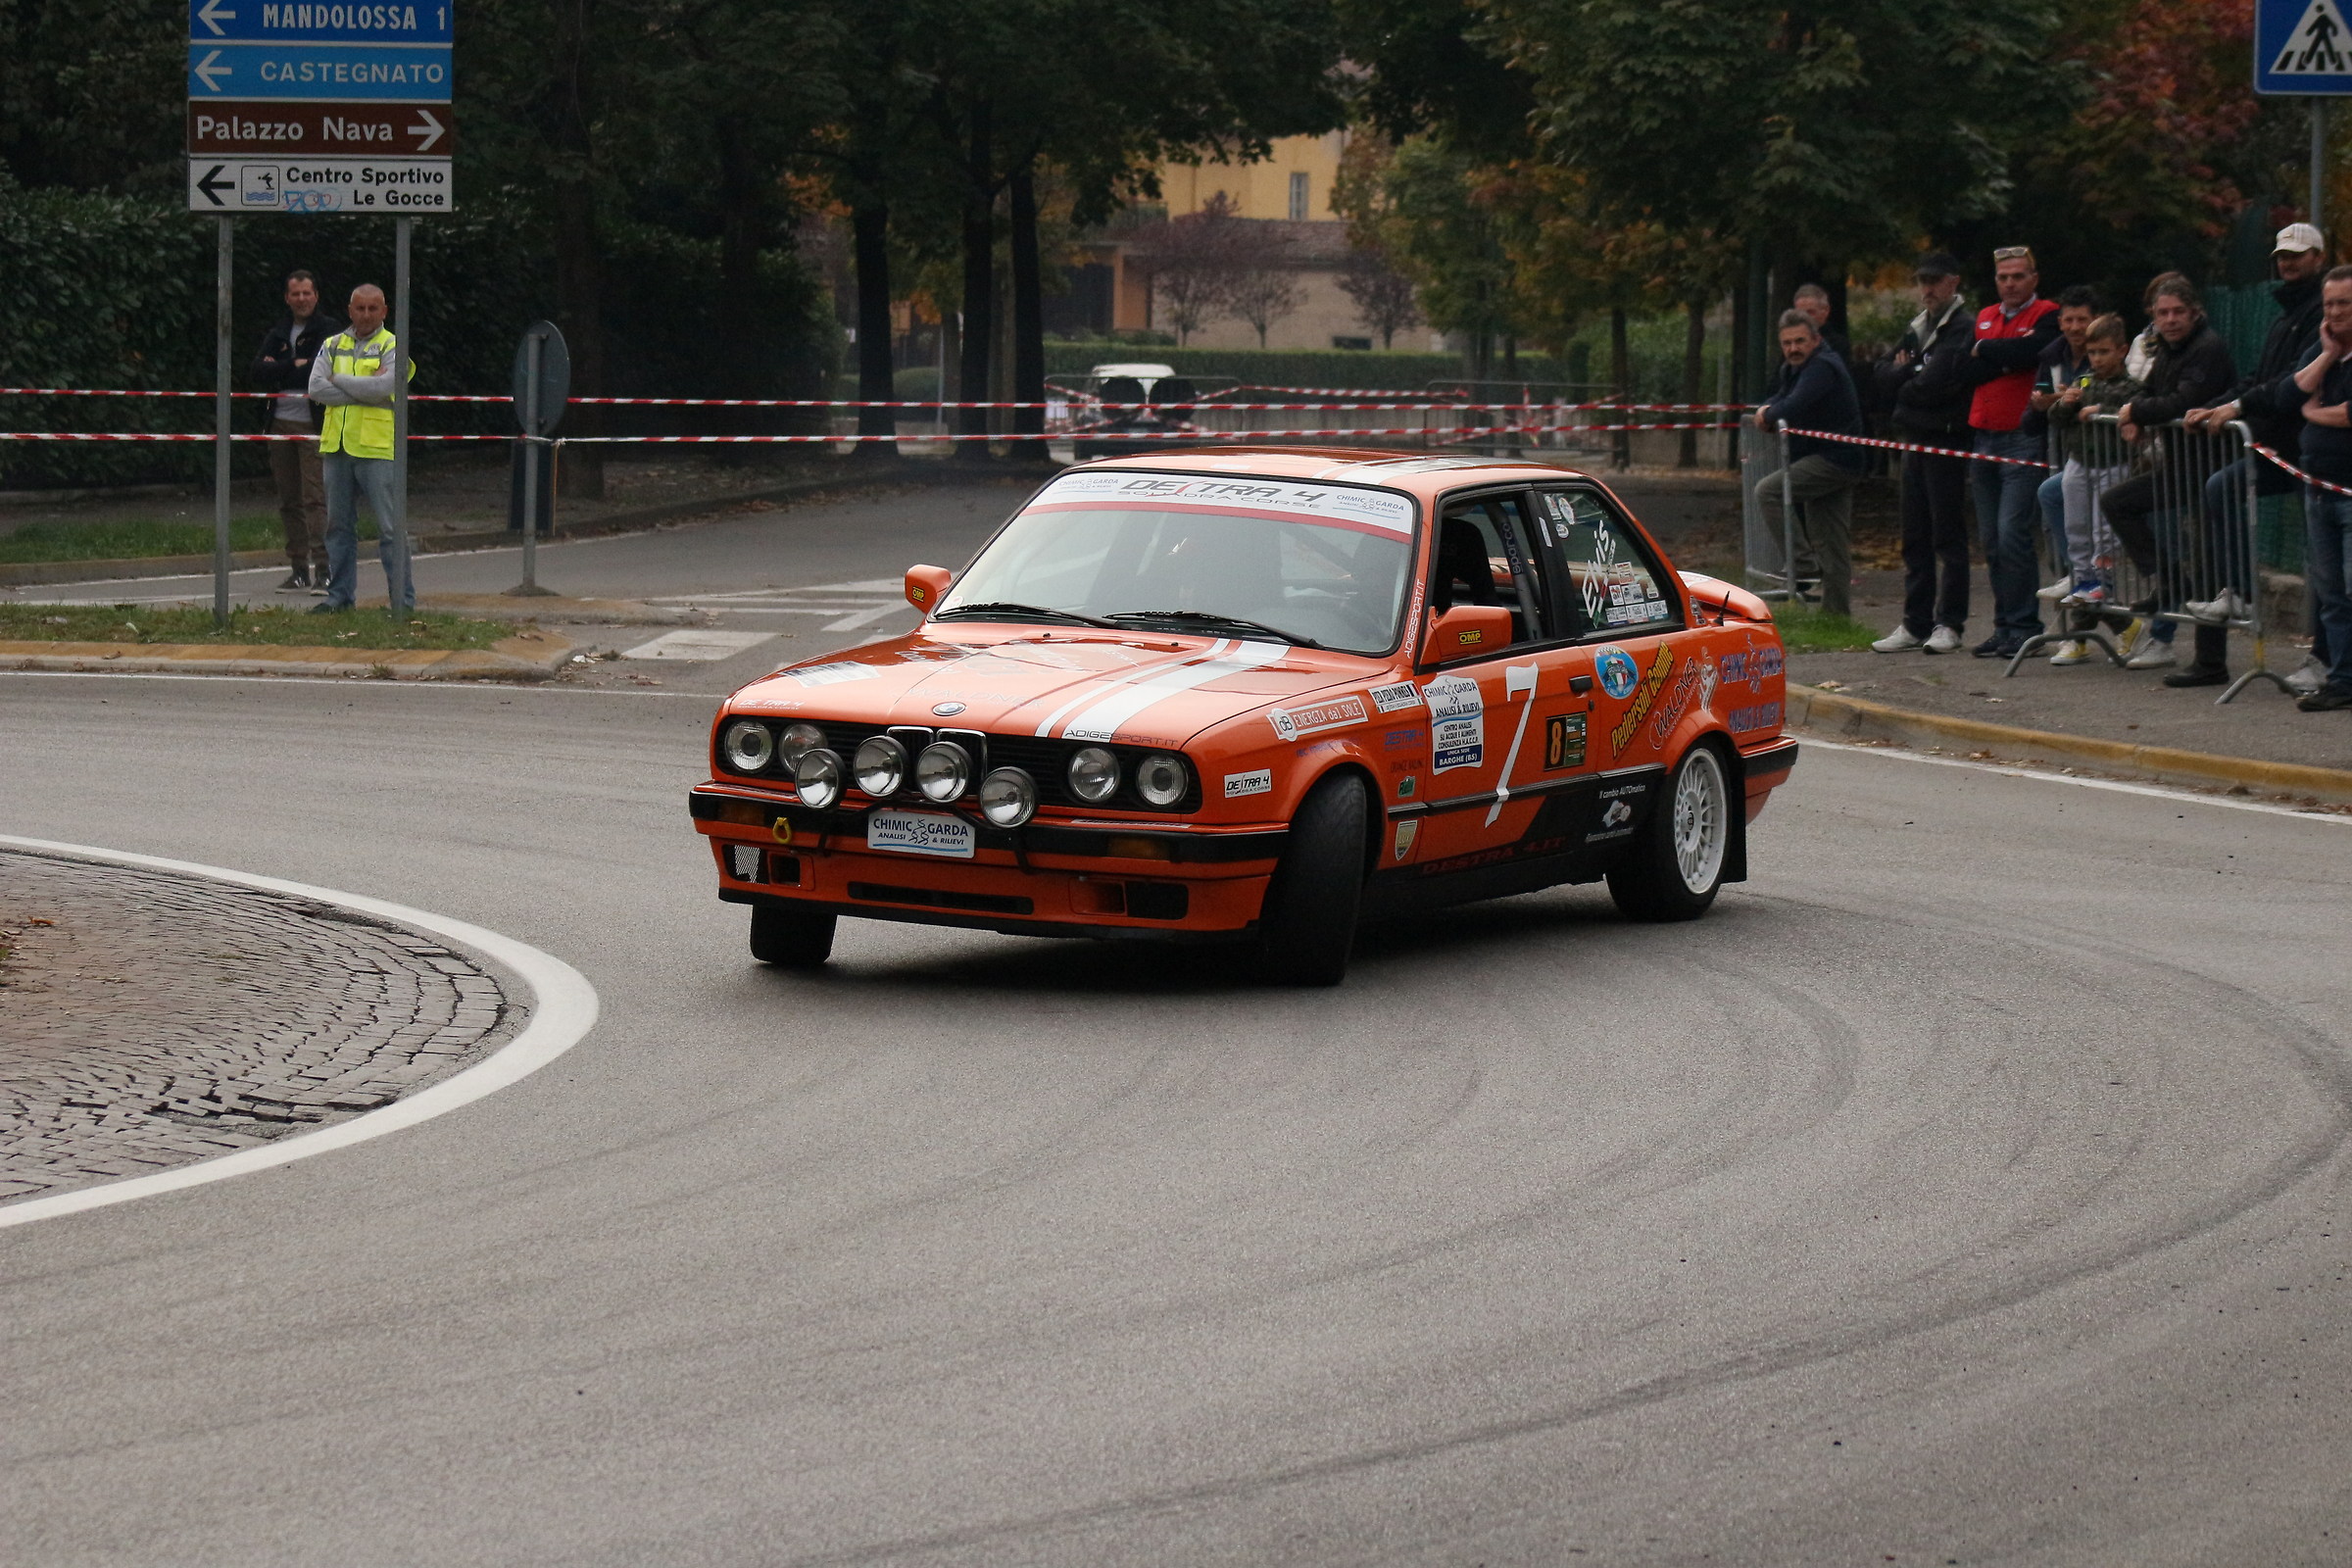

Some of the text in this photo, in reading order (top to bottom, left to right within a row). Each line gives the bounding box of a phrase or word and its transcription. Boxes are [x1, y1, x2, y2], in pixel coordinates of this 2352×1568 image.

[263, 4, 445, 30] MANDOLOSSA 1
[261, 62, 444, 83] CASTEGNATO
[197, 116, 394, 141] Palazzo Nava
[286, 168, 444, 186] Centro Sportivo
[354, 190, 374, 206] Le
[385, 190, 444, 206] Gocce
[1241, 498, 1322, 509] CORSE
[1294, 490, 1328, 502] 4
[1336, 494, 1404, 512] CHIMIC GARDA
[1459, 632, 1481, 642] OMP
[1424, 686, 1447, 698] CHIMIC
[1453, 682, 1478, 694] GARDA
[1654, 656, 1697, 738] WALDNER
[1611, 676, 1652, 760] Pedersoli
[1647, 640, 1674, 698] Gomme
[1293, 709, 1328, 727] ENERGIA
[1328, 708, 1343, 719] dal
[1343, 702, 1362, 717] SOLE
[1436, 706, 1456, 718] ANALISI
[1462, 702, 1480, 713] RILIEVI
[1444, 721, 1472, 733] CENTRO ANALISI
[1064, 729, 1178, 748] ADIGESPORT.IT
[1438, 739, 1462, 750] CONSULENZA
[1485, 661, 1540, 829] 7
[1550, 721, 1562, 764] 8
[1439, 753, 1478, 765] BARGHE (BS)
[1263, 775, 1270, 785] 4
[873, 818, 968, 837] CHIMIC GARDA
